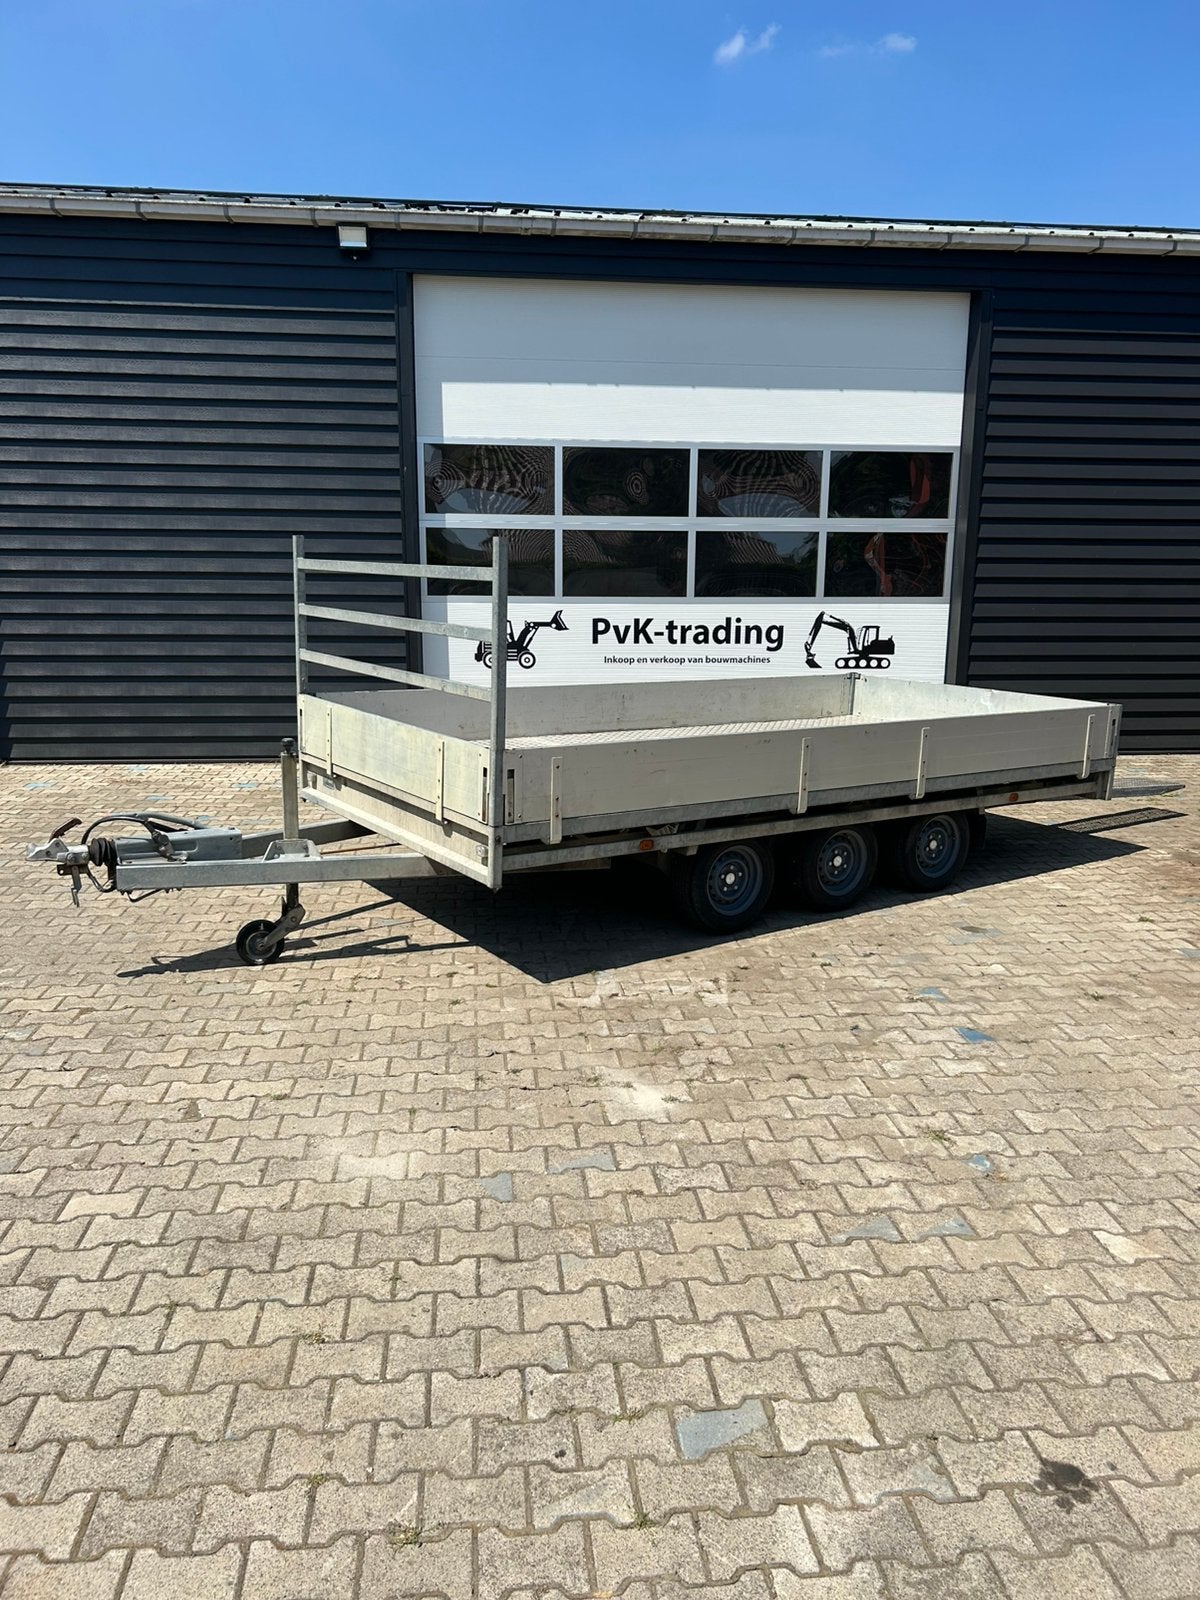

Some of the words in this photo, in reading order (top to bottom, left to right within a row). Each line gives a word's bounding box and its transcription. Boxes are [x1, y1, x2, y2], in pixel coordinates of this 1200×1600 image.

[592, 617, 785, 651] PvK-trading
[603, 655, 635, 665] Inkoop
[649, 655, 686, 665] verkoop
[705, 655, 771, 664] bouwmachines
